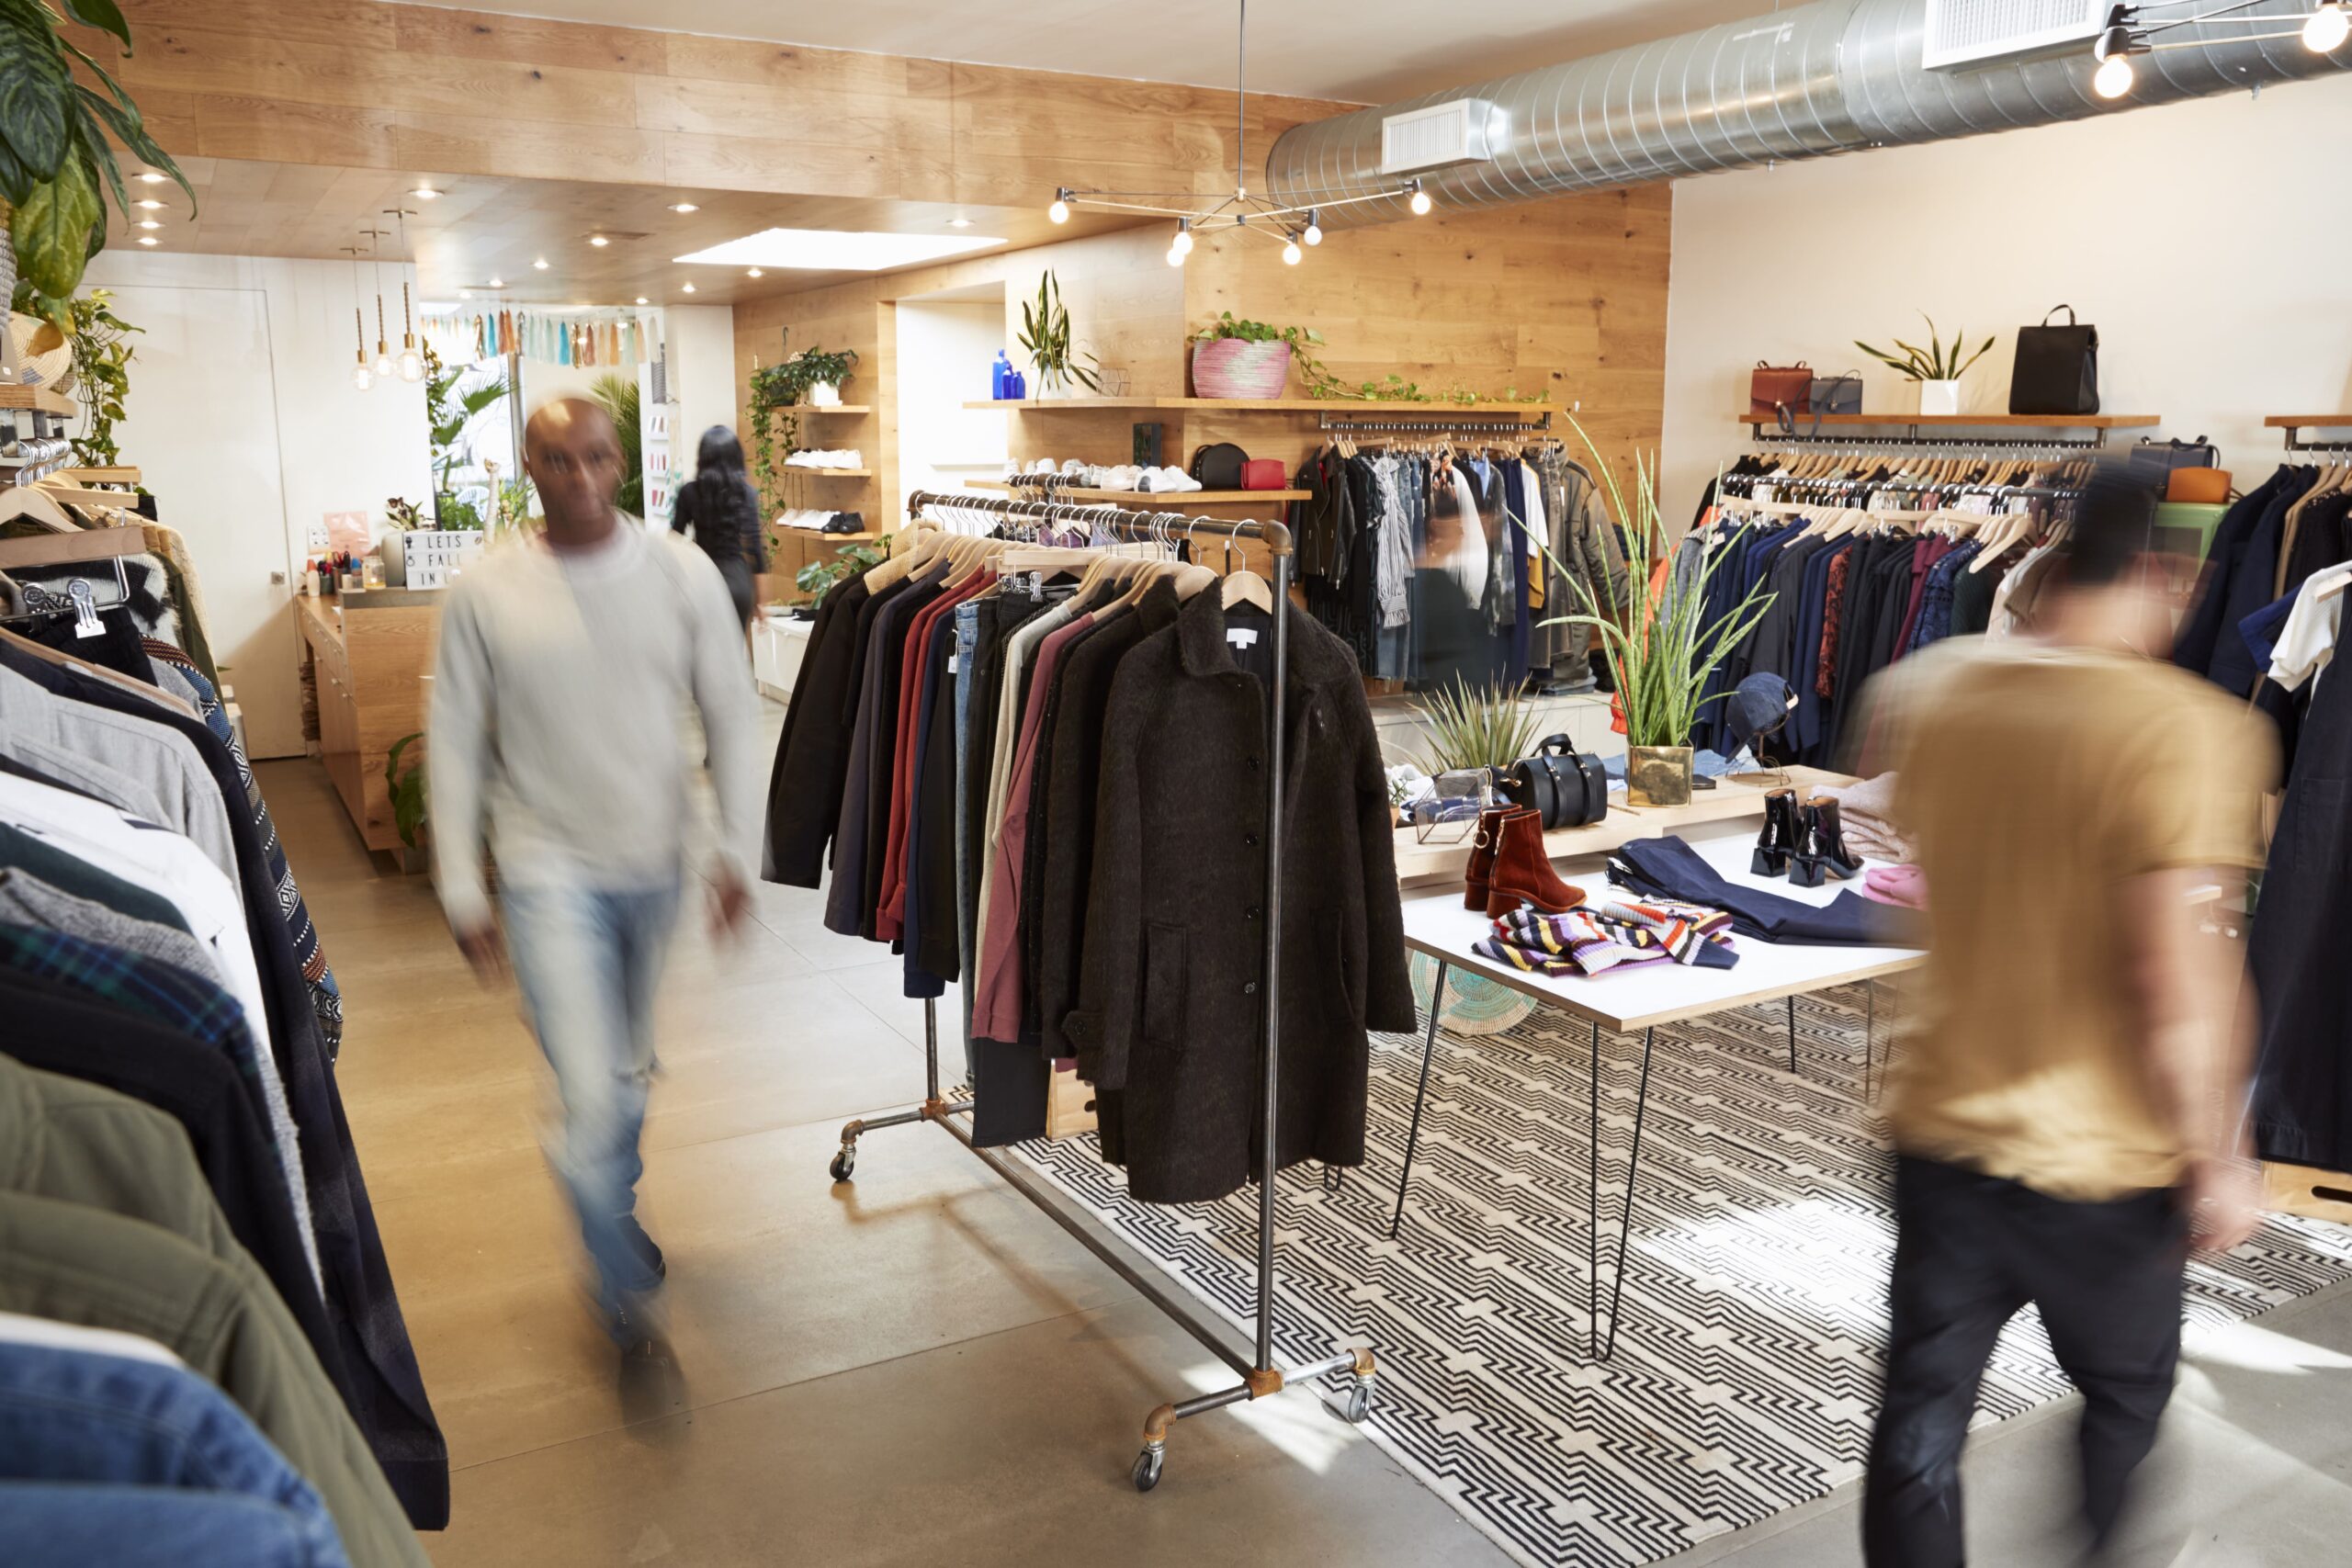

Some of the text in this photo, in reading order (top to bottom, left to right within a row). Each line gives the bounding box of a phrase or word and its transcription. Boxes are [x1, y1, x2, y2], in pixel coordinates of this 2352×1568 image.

[427, 535, 461, 548] LETS
[428, 554, 463, 567] FALL
[421, 572, 435, 585] IN
